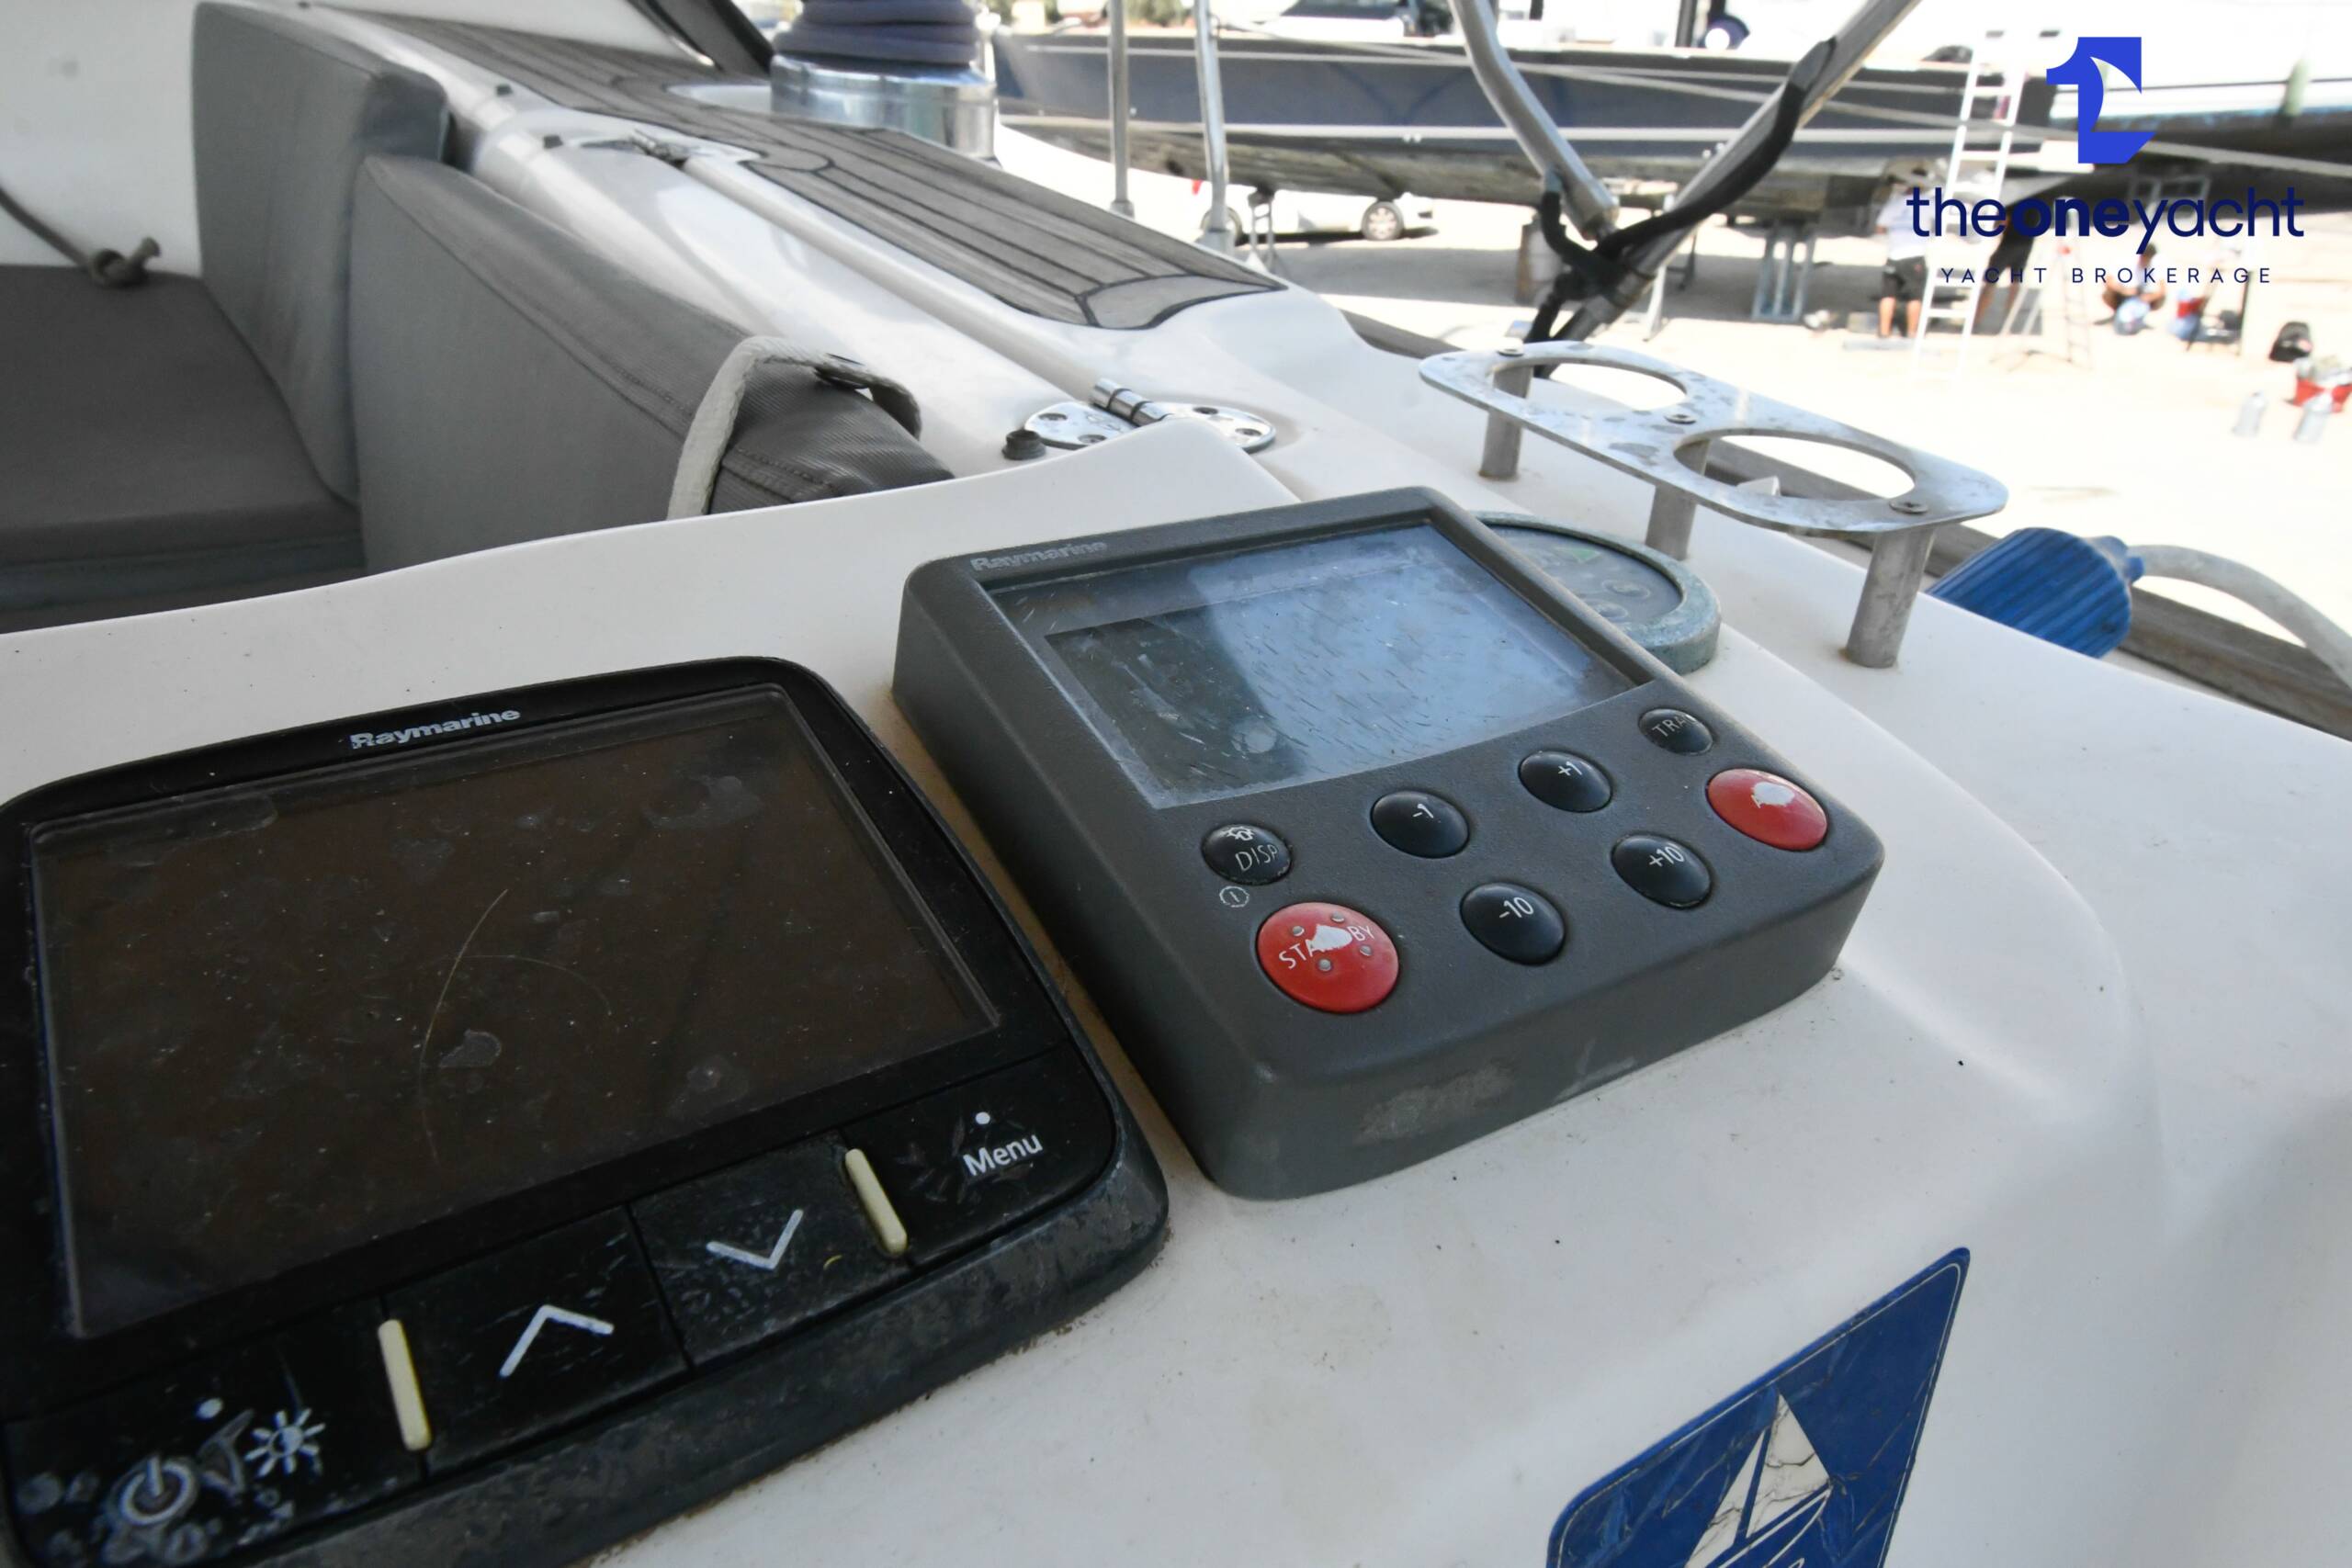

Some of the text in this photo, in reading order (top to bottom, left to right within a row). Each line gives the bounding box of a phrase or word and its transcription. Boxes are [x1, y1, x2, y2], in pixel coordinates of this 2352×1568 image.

[969, 540, 1108, 571] Raymarine
[349, 709, 521, 749] Raymarine
[1557, 761, 1582, 776] +1
[1412, 804, 1434, 818] -1
[1235, 843, 1279, 872] DISP
[1648, 844, 1685, 868] +10
[1498, 897, 1534, 919] -10
[1278, 925, 1375, 969] STABY
[963, 1134, 1044, 1177] Menu
